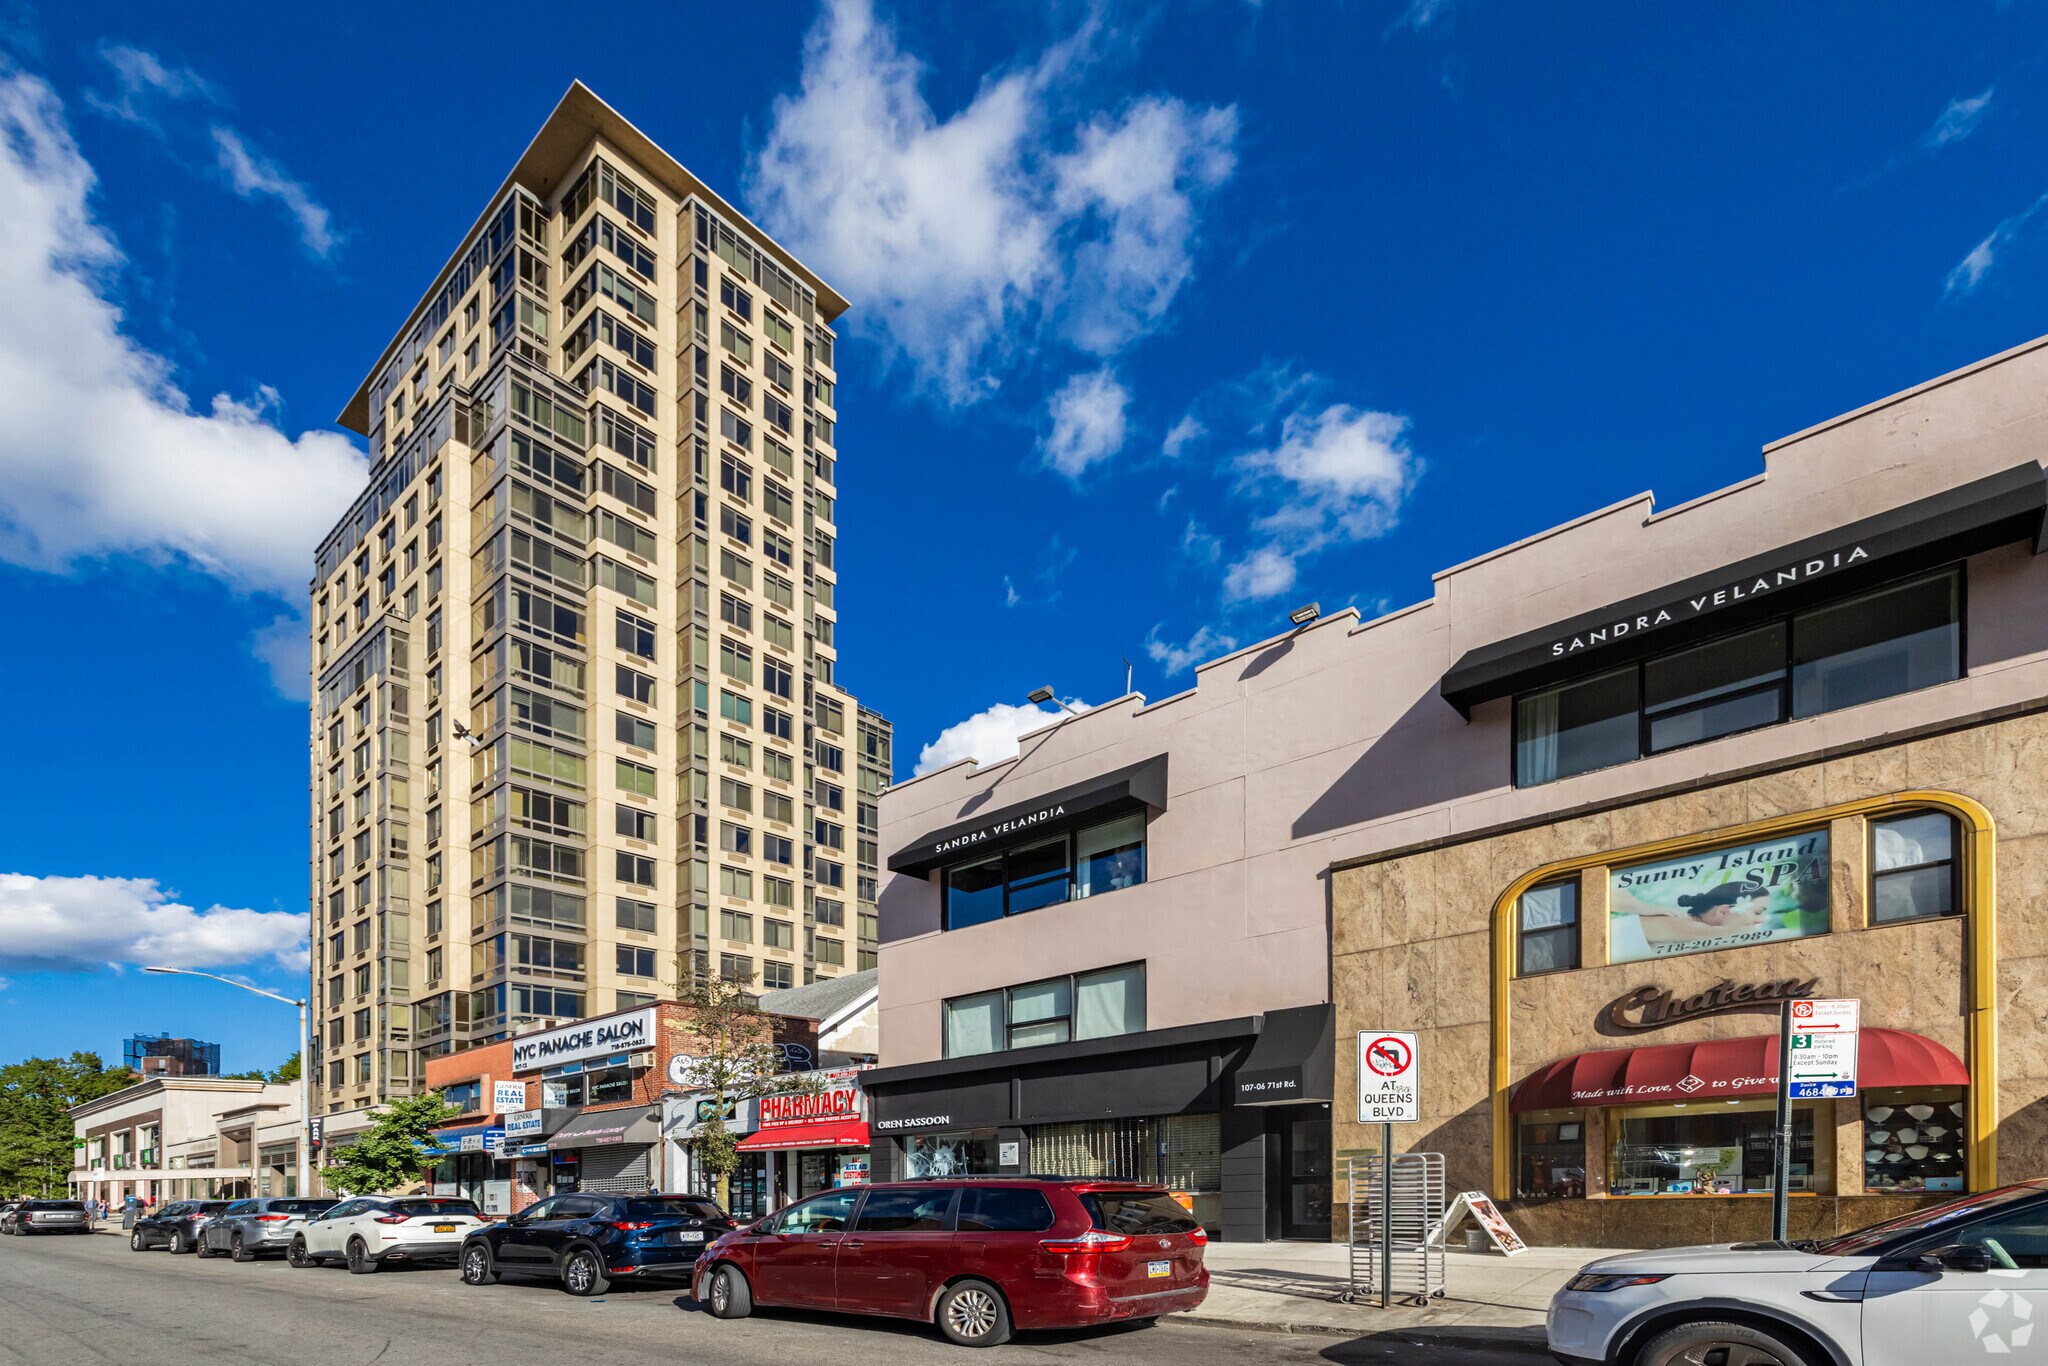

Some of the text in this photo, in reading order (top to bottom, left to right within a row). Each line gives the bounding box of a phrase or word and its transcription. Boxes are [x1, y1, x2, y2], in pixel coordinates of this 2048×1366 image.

[1552, 546, 1868, 655] SANDRA VELANDIA
[935, 805, 1065, 853] SANDRA VELANDIA
[1617, 837, 1817, 889] Sunny Island
[1740, 856, 1824, 893] SPA
[1656, 930, 1773, 954] 718-207-7989
[1611, 978, 1820, 1028] Chateau
[514, 1018, 644, 1063] NYC PANACHE SALON
[1796, 1035, 1807, 1048] 3
[1823, 1053, 1839, 1061] 10pm
[1241, 1080, 1297, 1091] 107-06 71st Rd.
[1381, 1080, 1397, 1090] AT
[1571, 1088, 1604, 1100] Made
[1606, 1085, 1633, 1097] with
[1636, 1083, 1672, 1095] Love,
[1712, 1078, 1727, 1088] to
[1732, 1075, 1766, 1089] Give
[497, 1089, 524, 1097] REAL
[1364, 1093, 1413, 1104] QUEENS
[496, 1096, 524, 1104] ESTATE
[760, 1088, 857, 1119] PHARMACY
[1373, 1106, 1404, 1117] BLVD
[507, 1122, 522, 1132] REAL
[522, 1119, 541, 1130] ESTATE
[877, 1115, 950, 1129] OREN SASSOON
[504, 1139, 524, 1147] PANACHE
